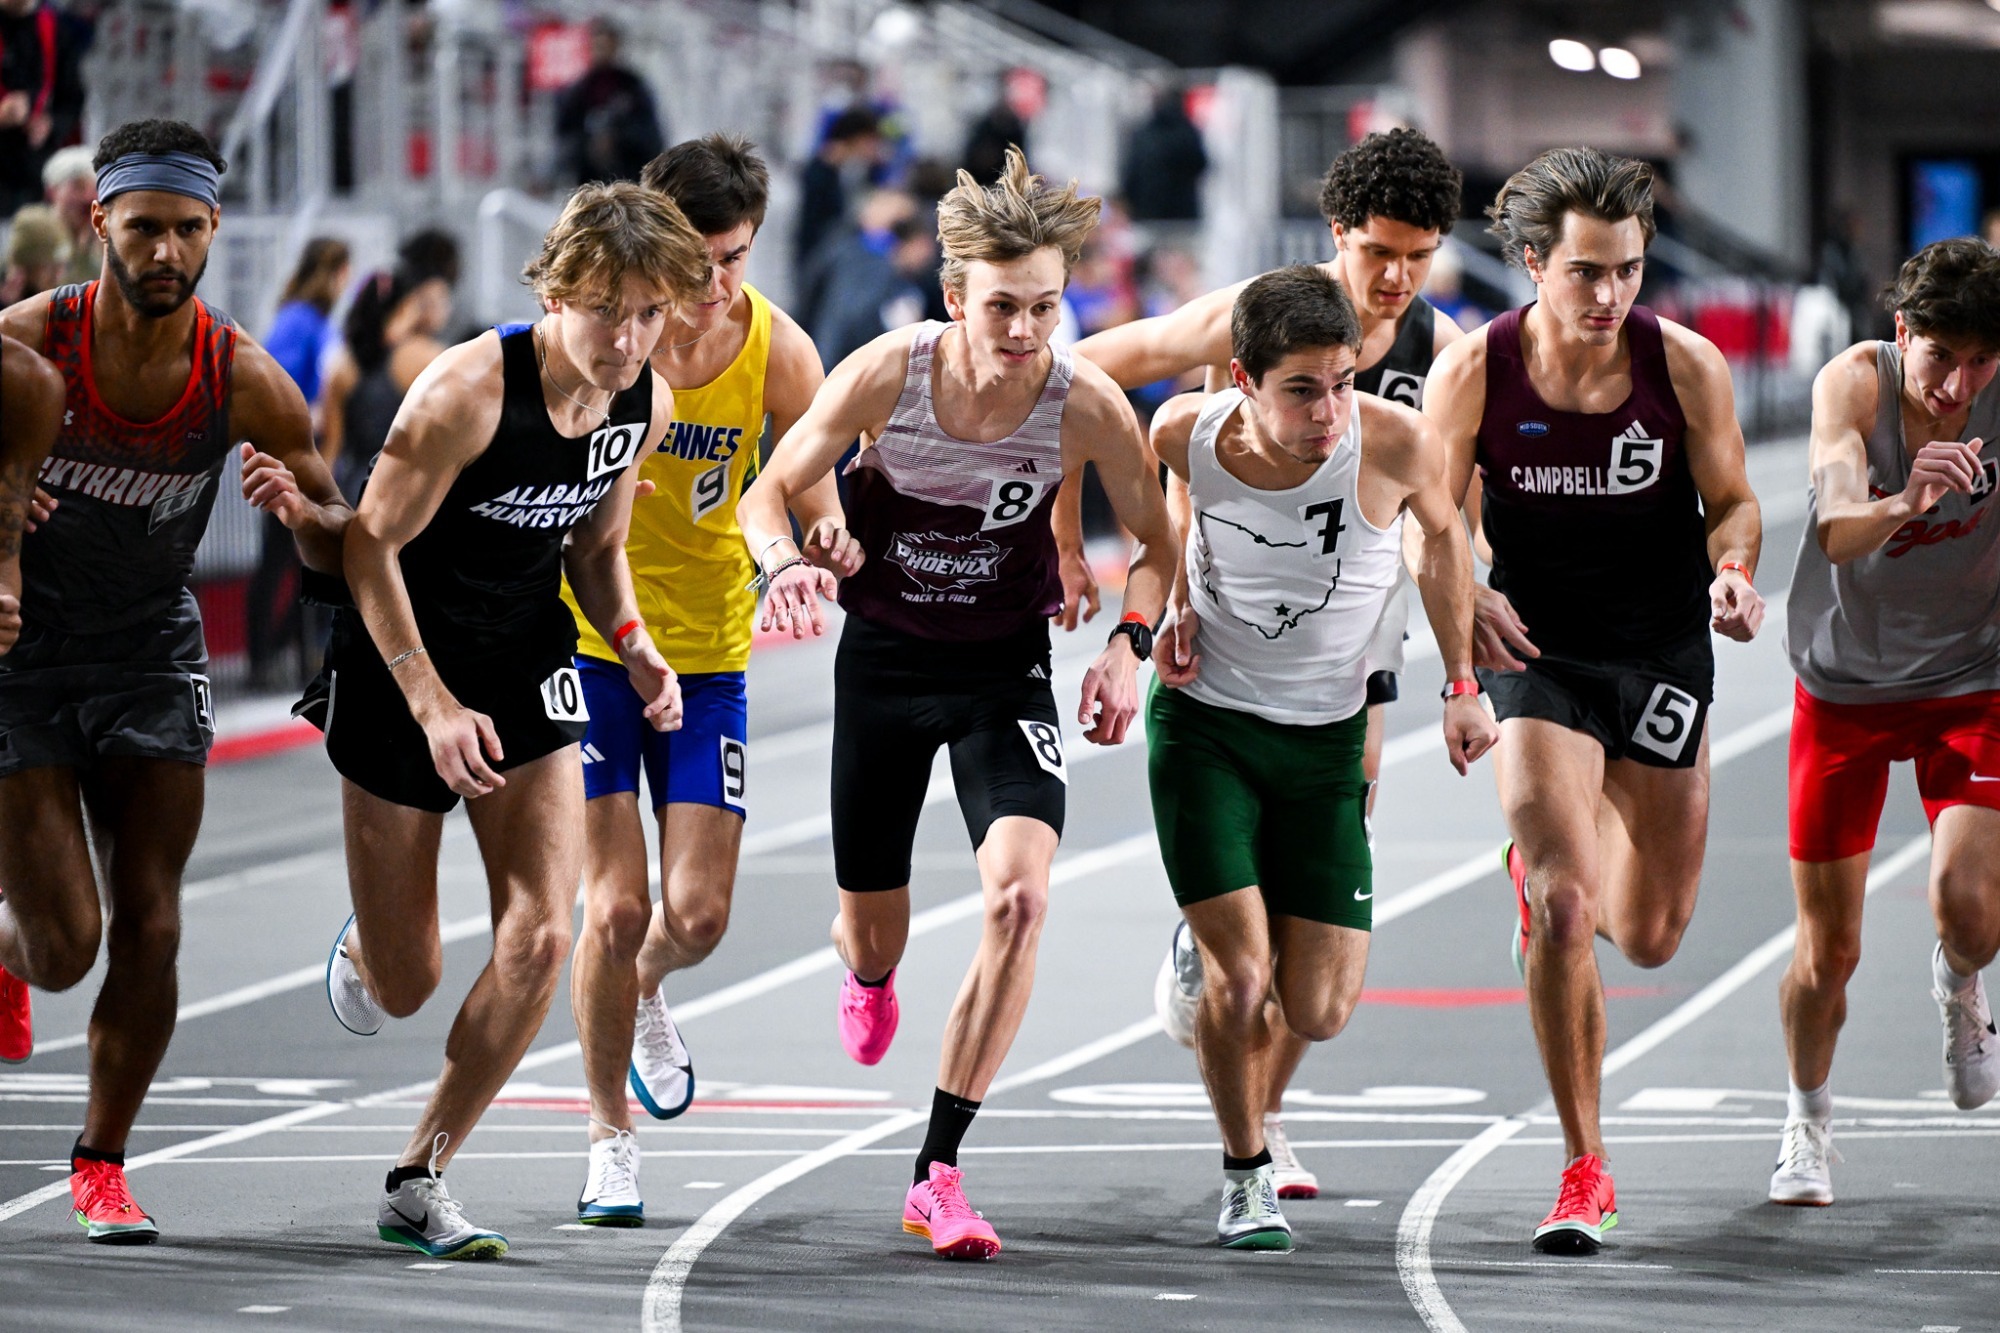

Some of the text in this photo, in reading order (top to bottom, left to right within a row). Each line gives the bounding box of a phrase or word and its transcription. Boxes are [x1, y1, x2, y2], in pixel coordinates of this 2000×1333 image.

[592, 428, 632, 471] 10
[1616, 442, 1654, 486] 5
[697, 464, 726, 513] 9
[992, 480, 1034, 522] 8
[1511, 465, 1606, 495] CAMPBELL
[1304, 497, 1346, 555] 7
[896, 541, 999, 576] PHOENIX
[901, 591, 977, 604] TRACK & FIELD
[543, 672, 578, 716] 10
[1646, 687, 1691, 744] 5
[1028, 722, 1062, 768] 8
[723, 742, 745, 799] 9
